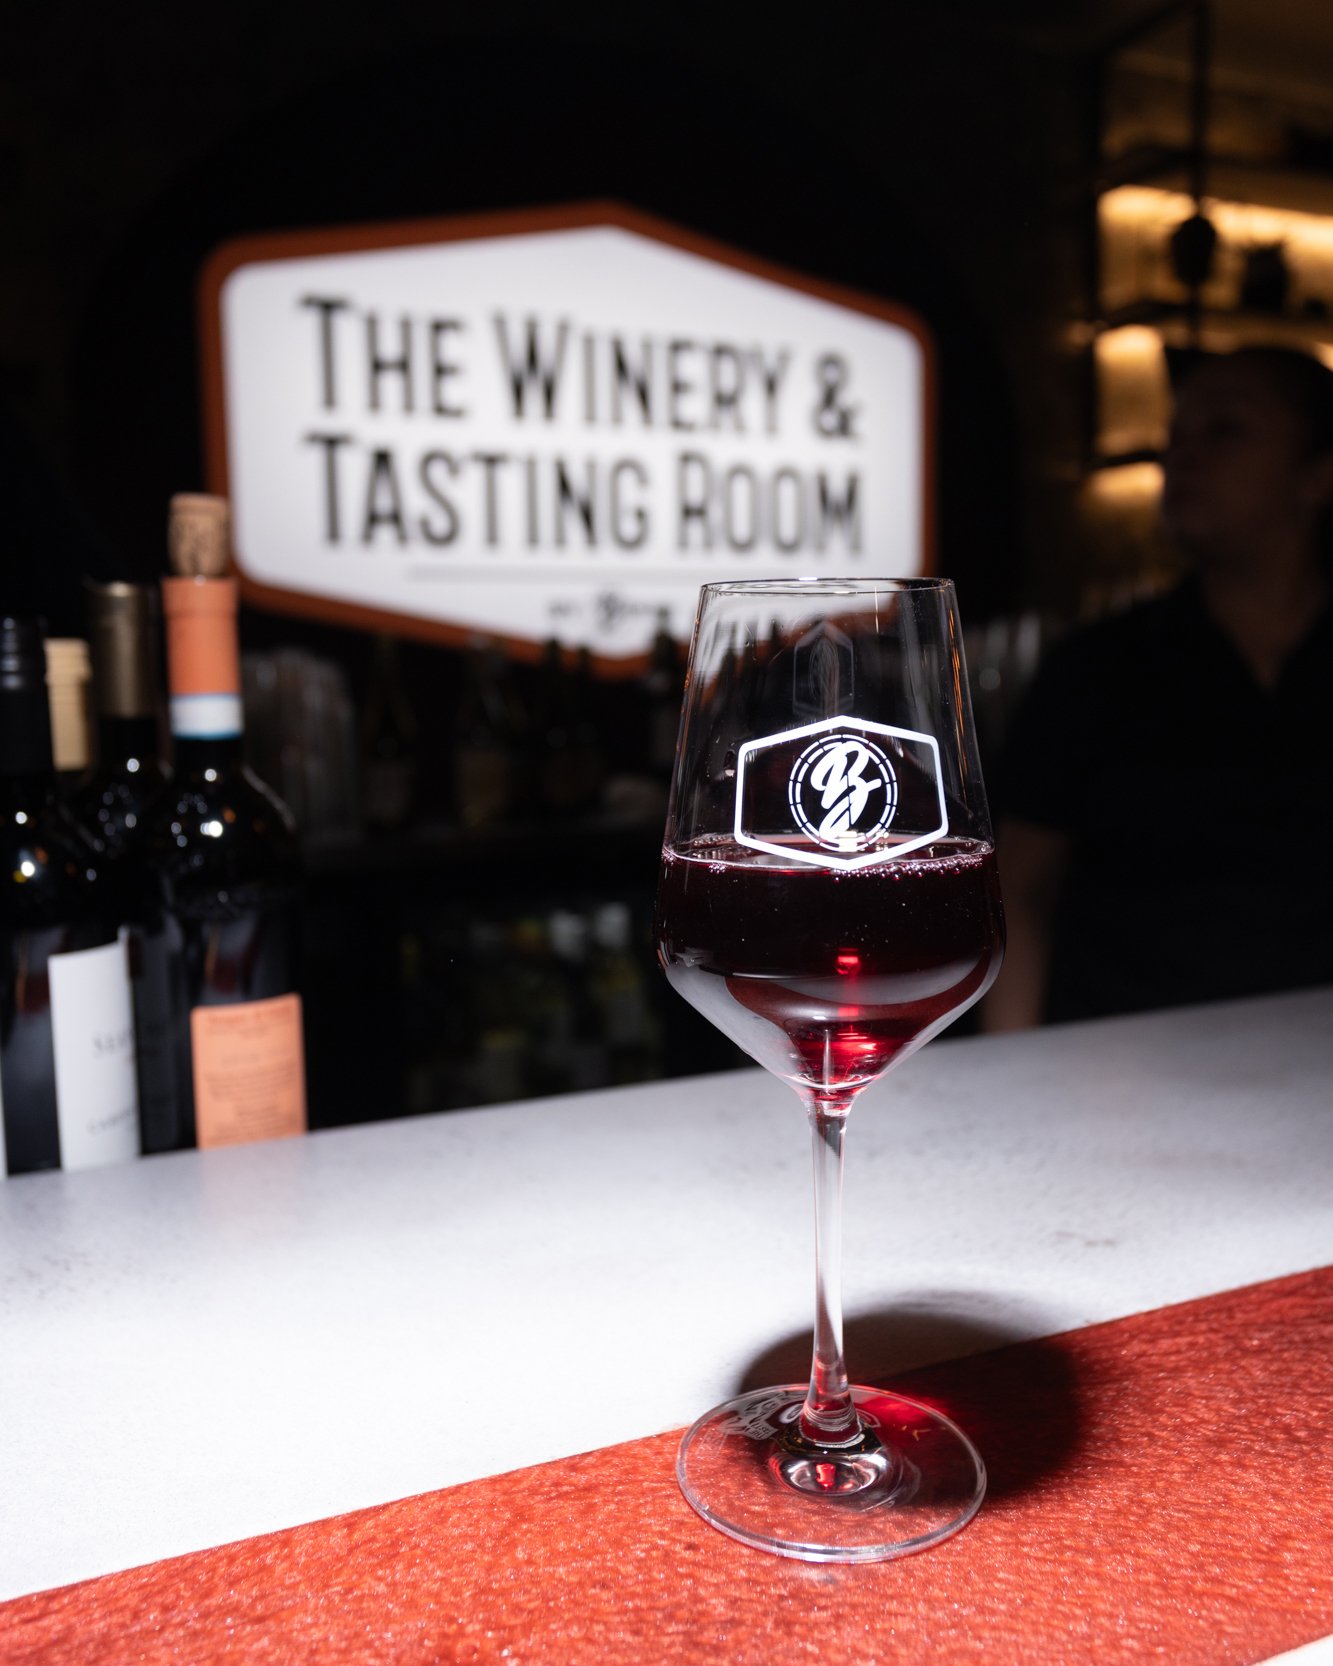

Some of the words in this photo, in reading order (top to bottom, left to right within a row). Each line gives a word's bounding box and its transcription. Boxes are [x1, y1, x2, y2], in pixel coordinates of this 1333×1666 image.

[299, 294, 467, 419] THE
[493, 312, 793, 436] WINERY
[812, 350, 861, 440] &
[302, 430, 651, 553] TASTING
[675, 451, 863, 557] ROOM
